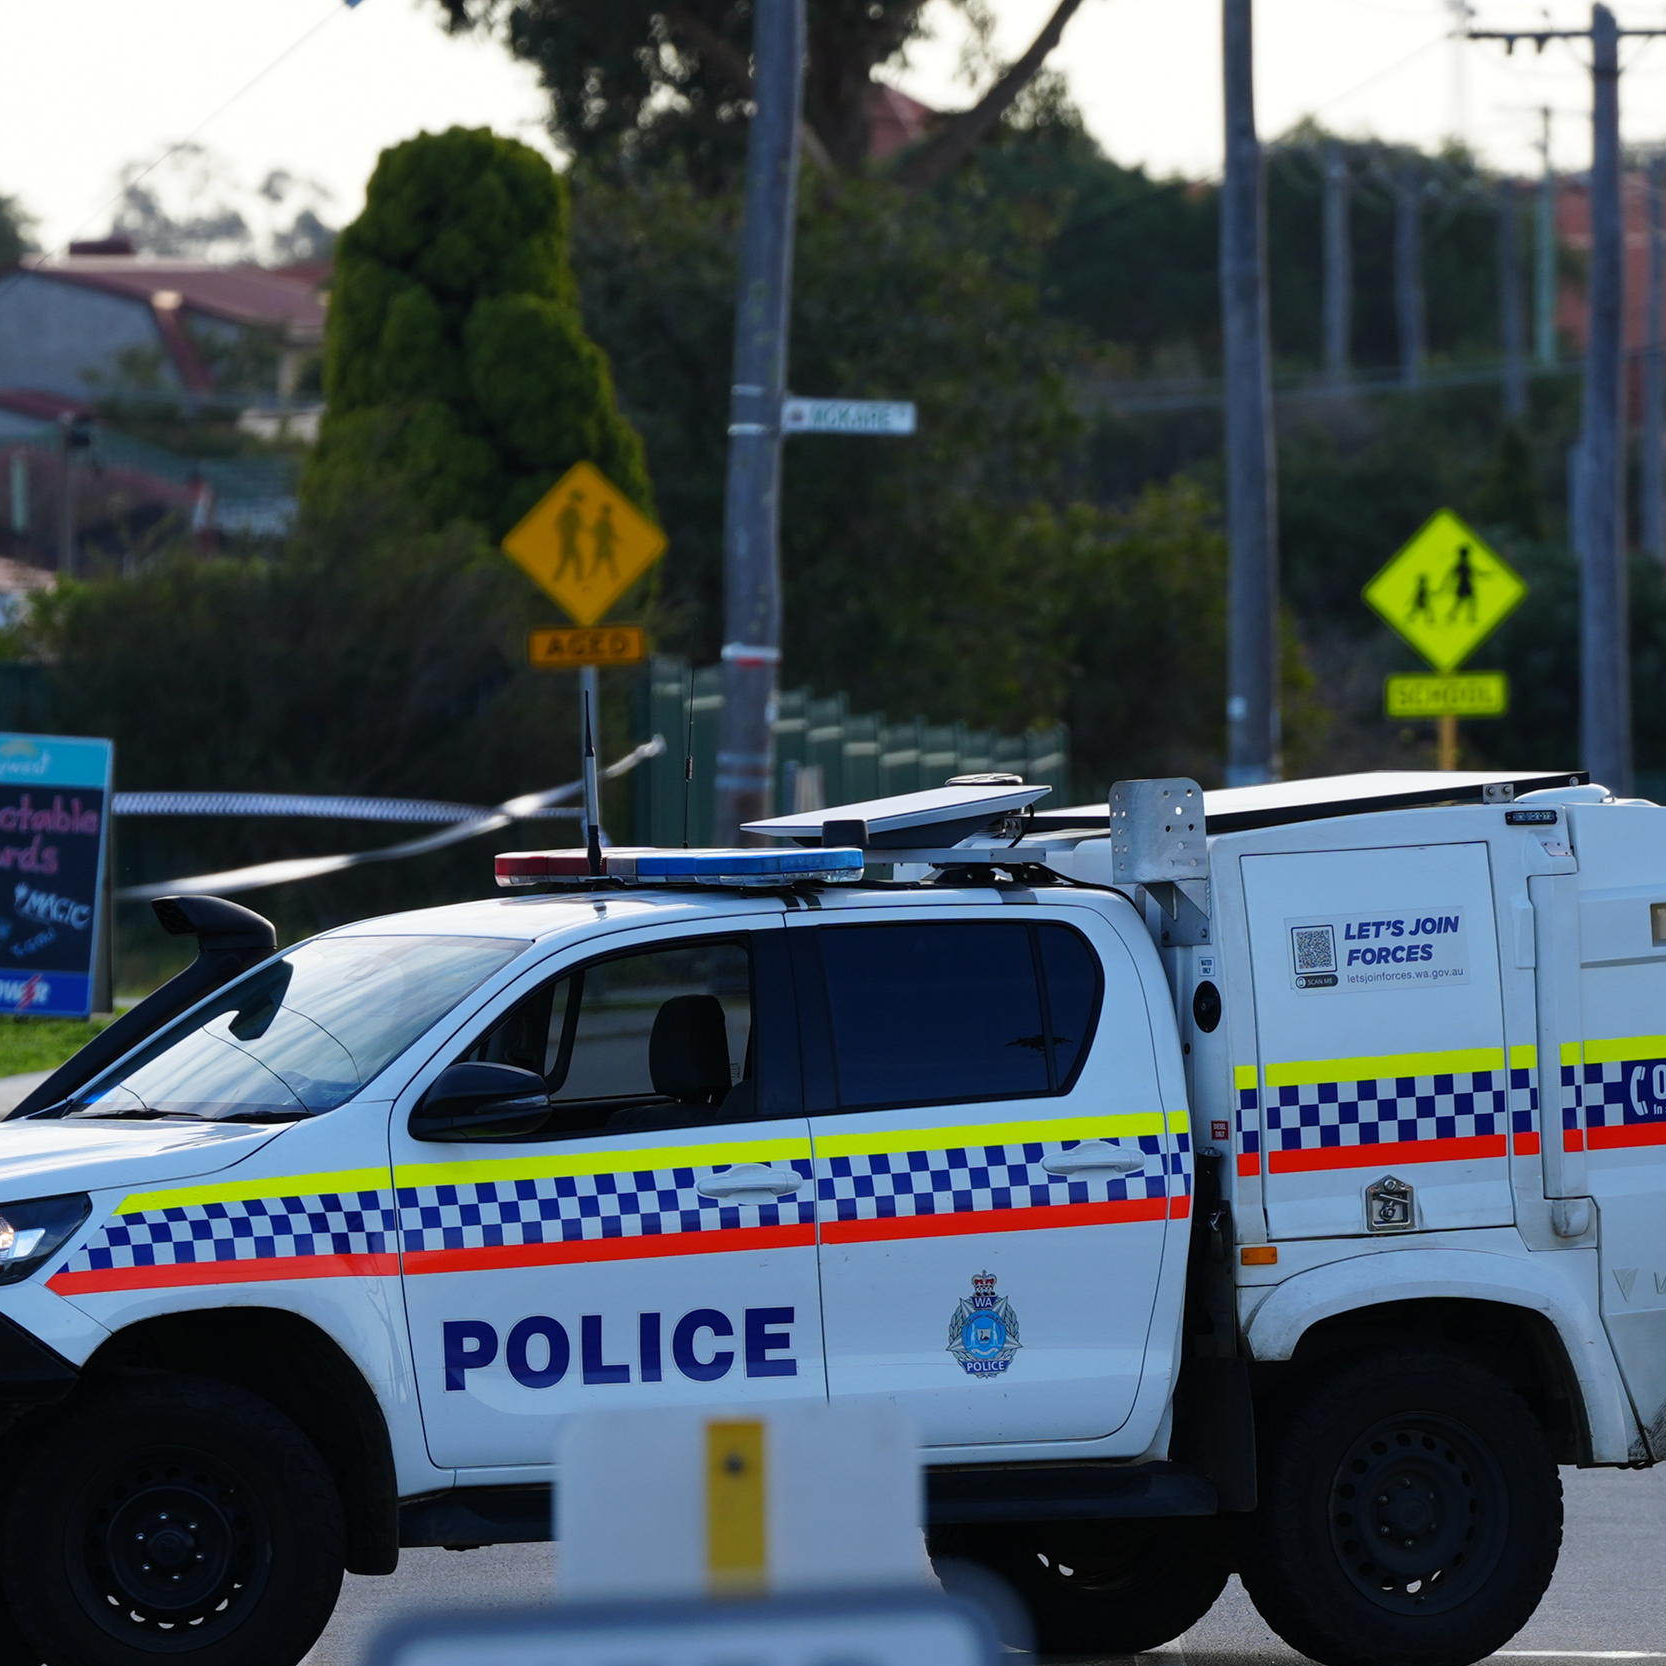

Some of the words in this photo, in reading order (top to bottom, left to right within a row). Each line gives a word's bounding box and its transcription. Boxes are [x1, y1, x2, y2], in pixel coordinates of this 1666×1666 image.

[1344, 919, 1405, 941] LET'S
[1409, 915, 1460, 936] JOIN
[1346, 943, 1434, 966] FORCES
[1347, 967, 1464, 985] letsjoinforces.wa.gov.au
[1653, 1103, 1663, 1115] In
[974, 1297, 993, 1307] WA
[443, 1306, 798, 1392] POLICE
[966, 1361, 1005, 1372] POLICE
